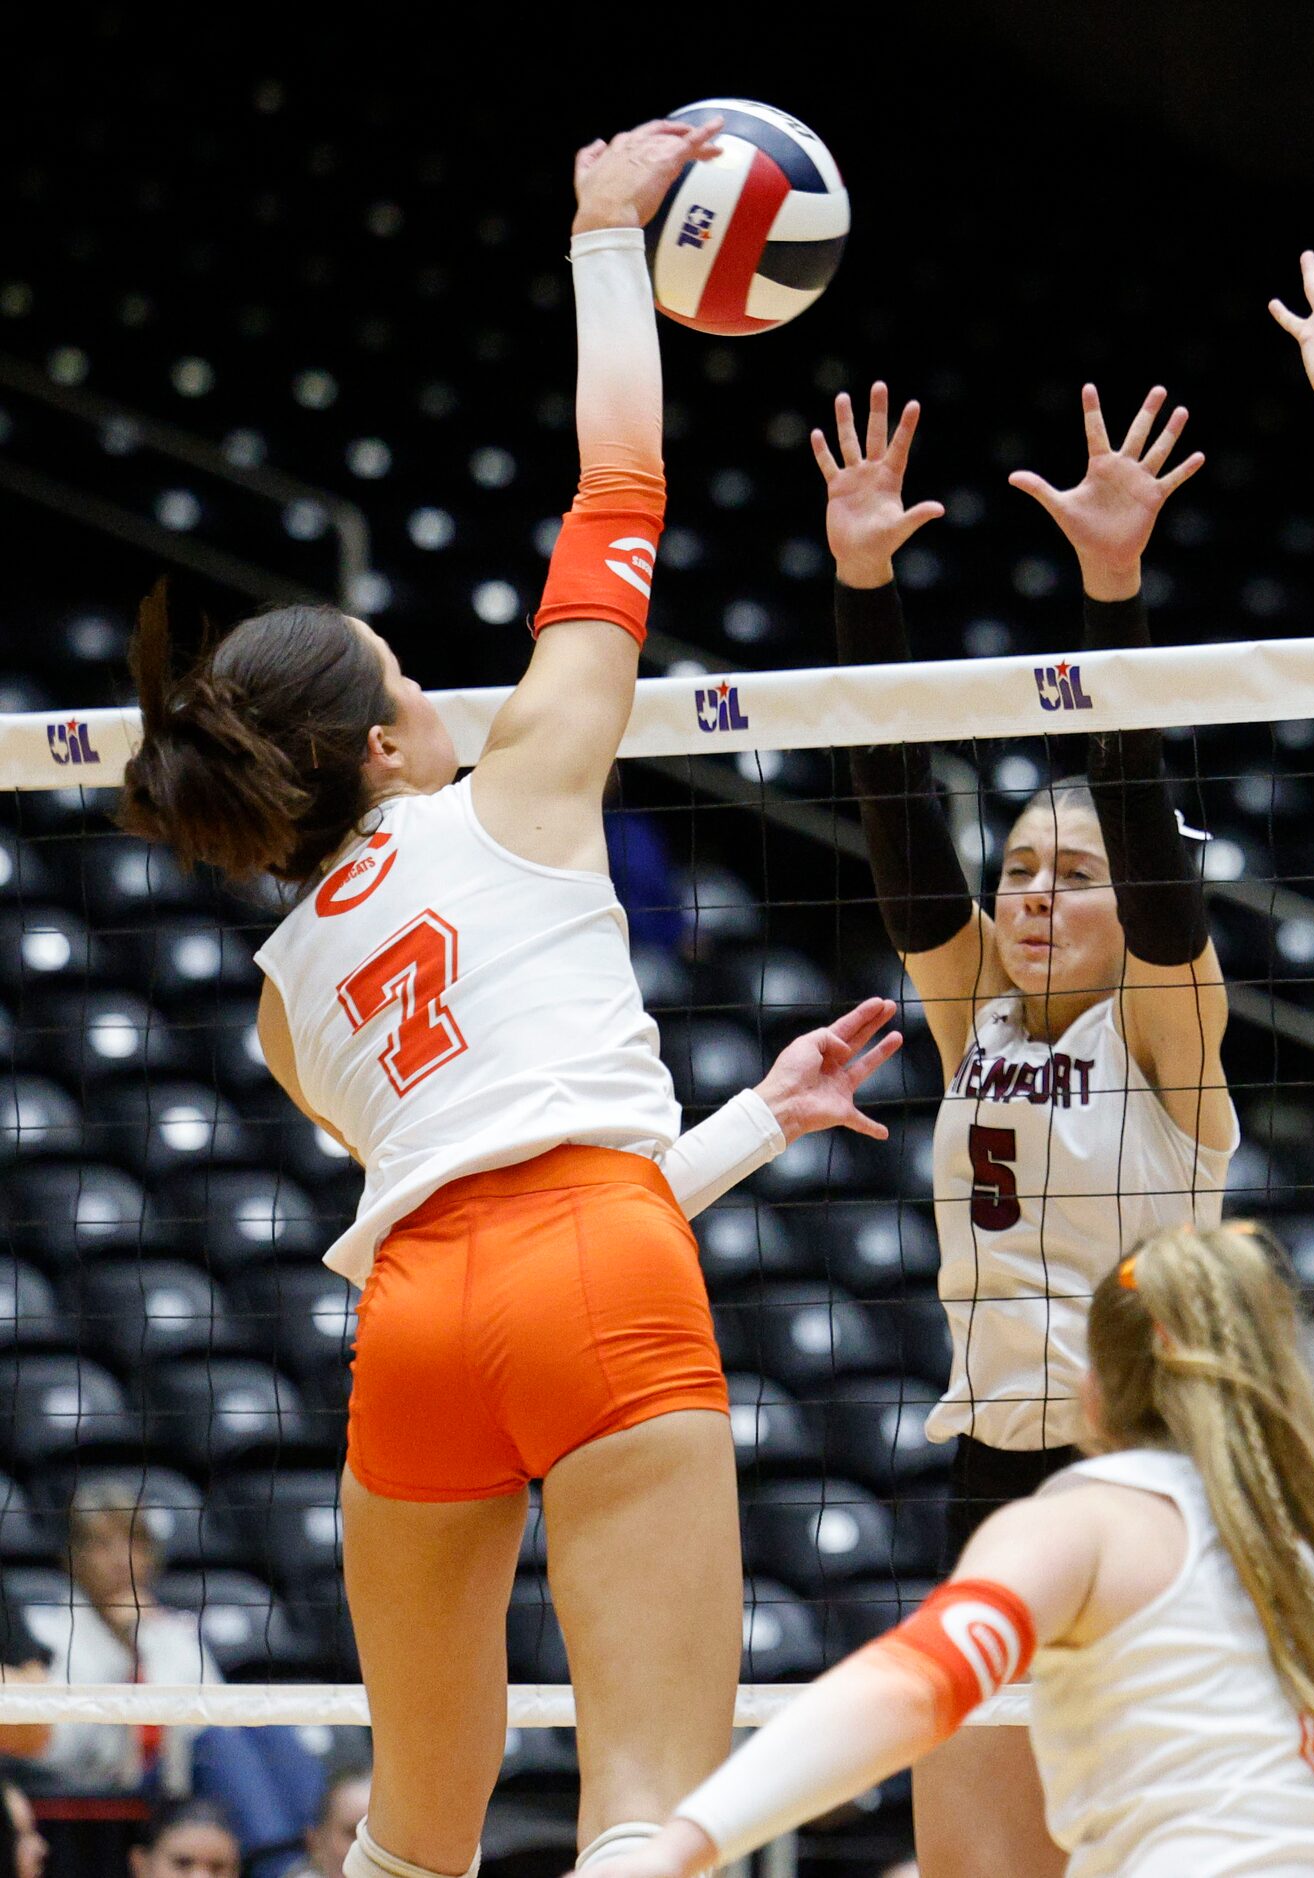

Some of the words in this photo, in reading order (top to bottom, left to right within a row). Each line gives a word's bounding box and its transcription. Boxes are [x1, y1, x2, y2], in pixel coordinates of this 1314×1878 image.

[695, 679, 749, 732] UIL
[1034, 659, 1093, 711] UIL
[335, 908, 469, 1099] 7
[968, 1124, 1021, 1232] 5
